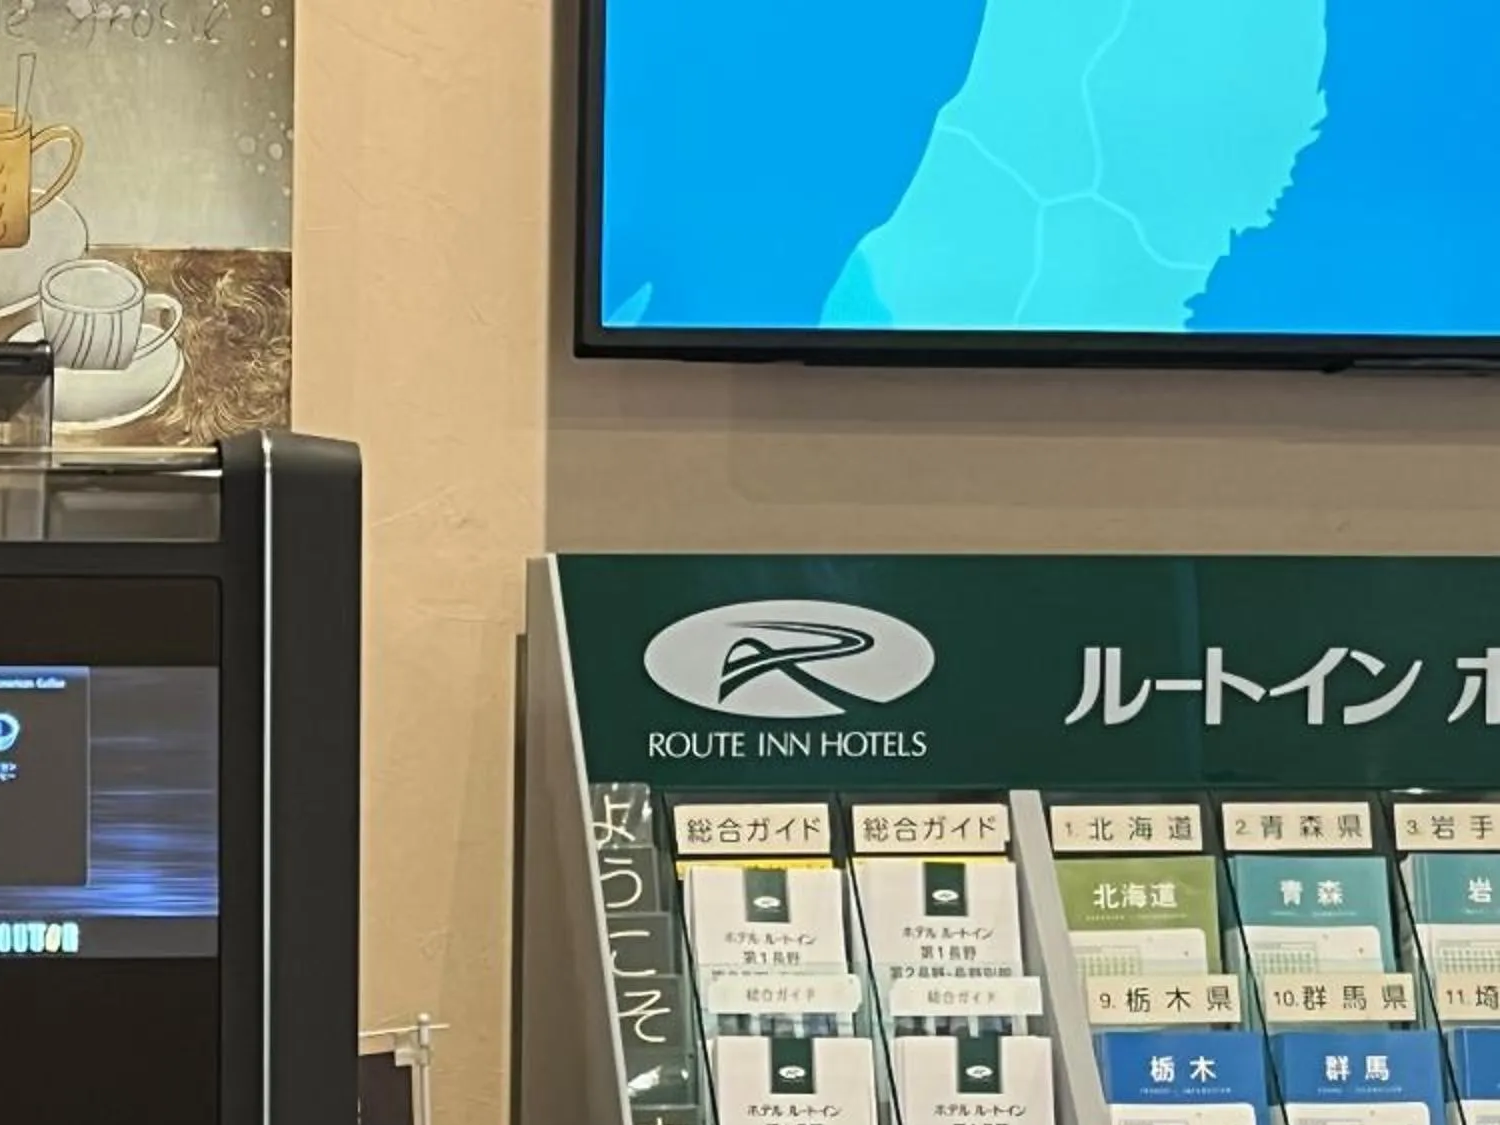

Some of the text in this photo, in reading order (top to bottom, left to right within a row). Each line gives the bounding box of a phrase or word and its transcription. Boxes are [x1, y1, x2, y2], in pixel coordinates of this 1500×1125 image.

[1064, 646, 1424, 726] ルートイン
[649, 730, 927, 757] ROUTE INN HOTELS
[687, 816, 821, 844] 総合ガイド
[863, 815, 997, 843] 総合ガイド
[1093, 882, 1179, 910] 北海道
[1280, 879, 1345, 906] 青森
[1150, 1055, 1217, 1083] 栃木
[1324, 1055, 1391, 1082] 群馬
